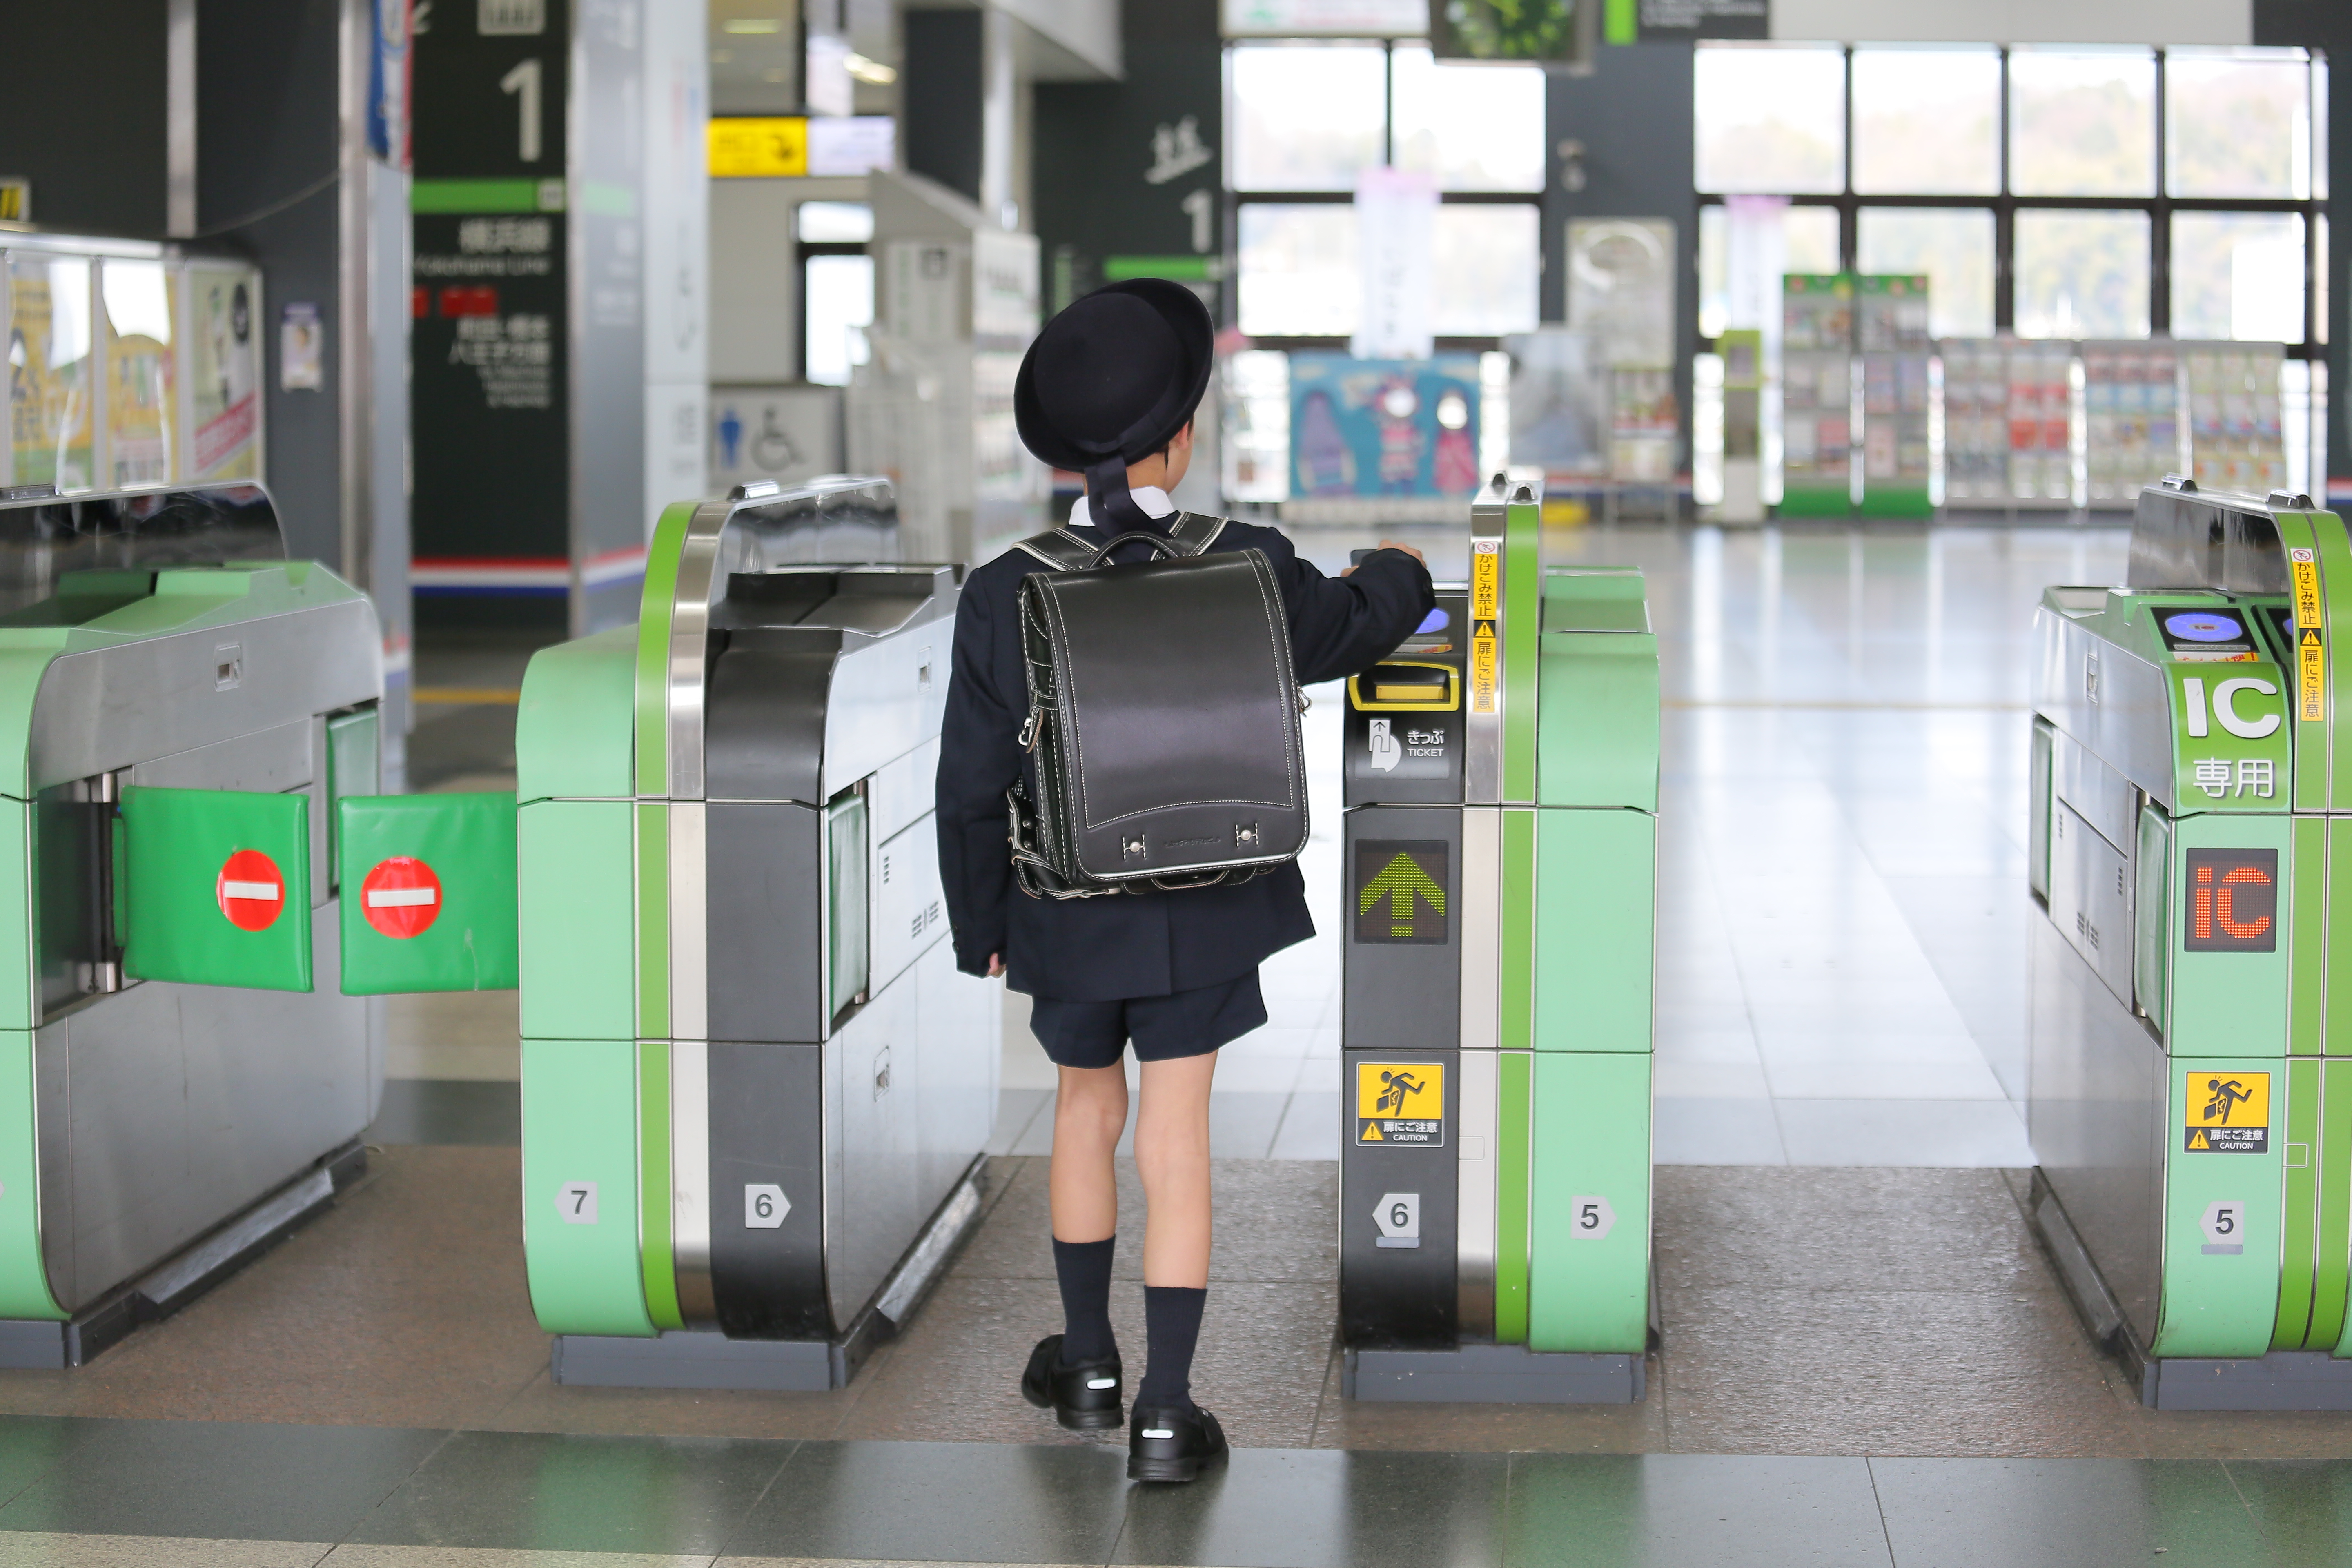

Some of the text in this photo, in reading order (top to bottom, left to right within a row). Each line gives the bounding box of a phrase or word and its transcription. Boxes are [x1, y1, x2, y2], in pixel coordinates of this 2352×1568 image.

[500, 58, 541, 161] 1
[1182, 190, 1212, 253] 1
[1478, 554, 1493, 617] かけこみ禁止
[2297, 563, 2316, 624] かけこみ禁止
[1476, 641, 1492, 709] 扉にご注意
[2305, 650, 2319, 717] 扉にご注意
[2183, 677, 2281, 739] IC
[1407, 730, 1444, 745] きっぷ
[1407, 748, 1444, 757] TICKET
[2193, 757, 2274, 797] 専用
[1383, 1122, 1437, 1133] 扉にご注意
[2210, 1129, 2263, 1141] 扉にご注意
[571, 1191, 588, 1214] 7
[755, 1194, 773, 1218] 6
[1390, 1203, 1409, 1227] 6
[1579, 1205, 1599, 1229] 5
[2215, 1210, 2234, 1235] 5
